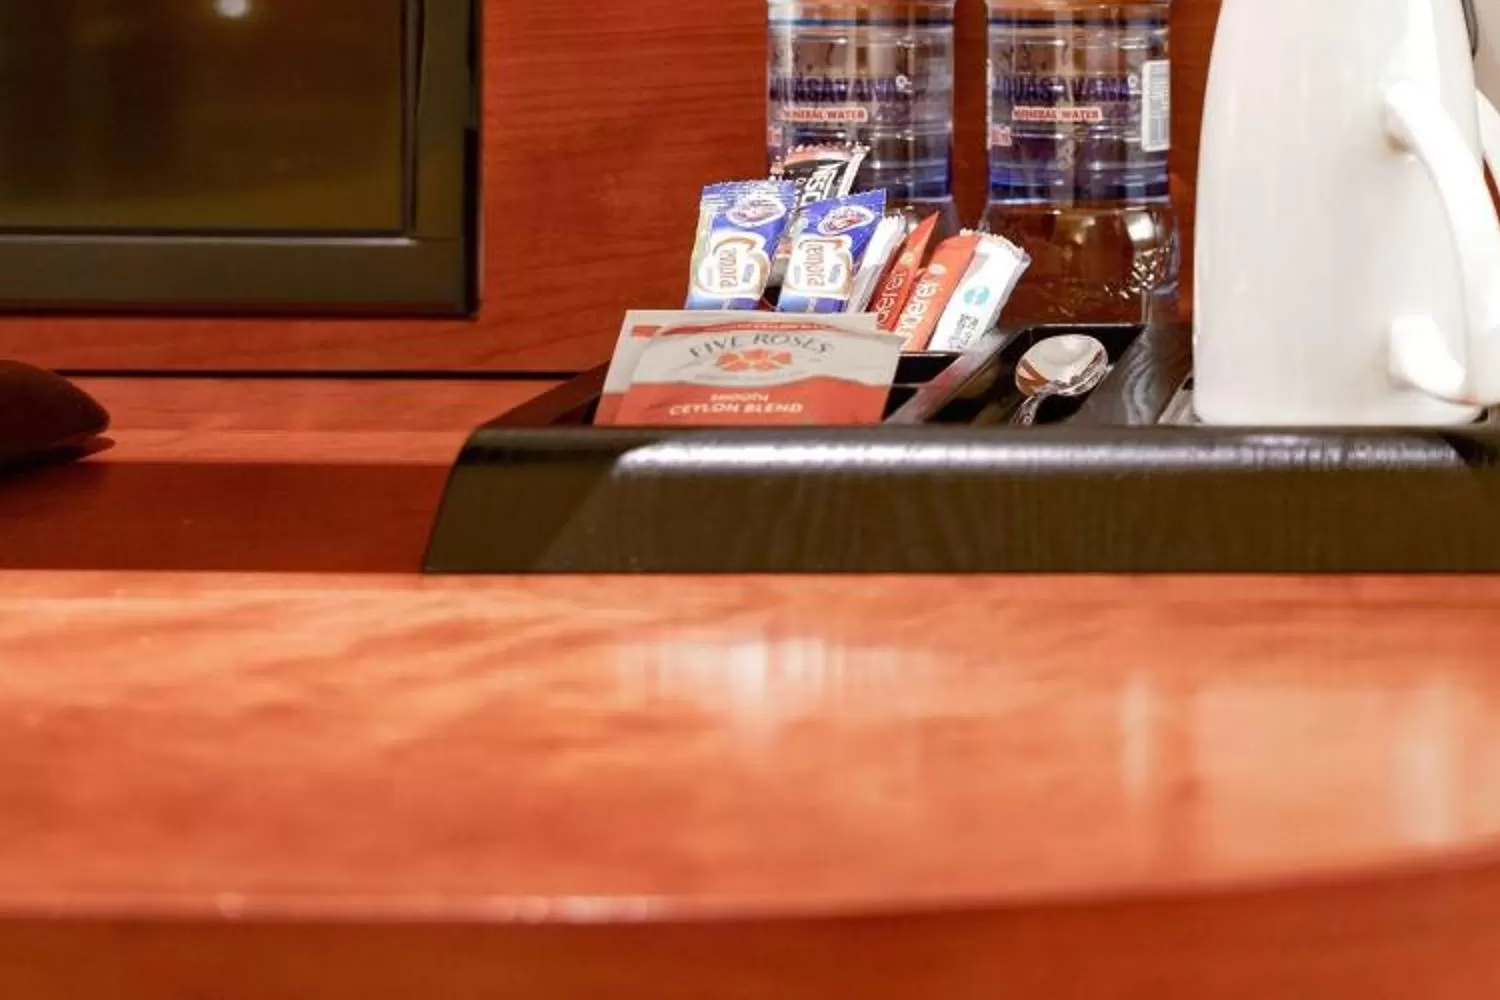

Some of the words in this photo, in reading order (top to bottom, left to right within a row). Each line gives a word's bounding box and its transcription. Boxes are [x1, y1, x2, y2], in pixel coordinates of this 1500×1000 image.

[828, 109, 866, 120] WATER
[1060, 109, 1100, 120] WATER
[689, 336, 743, 357] FIVE
[752, 333, 835, 353] ROSES
[711, 393, 769, 402] SMOOTH
[668, 403, 740, 417] CEYLON
[743, 403, 804, 414] BLEND
